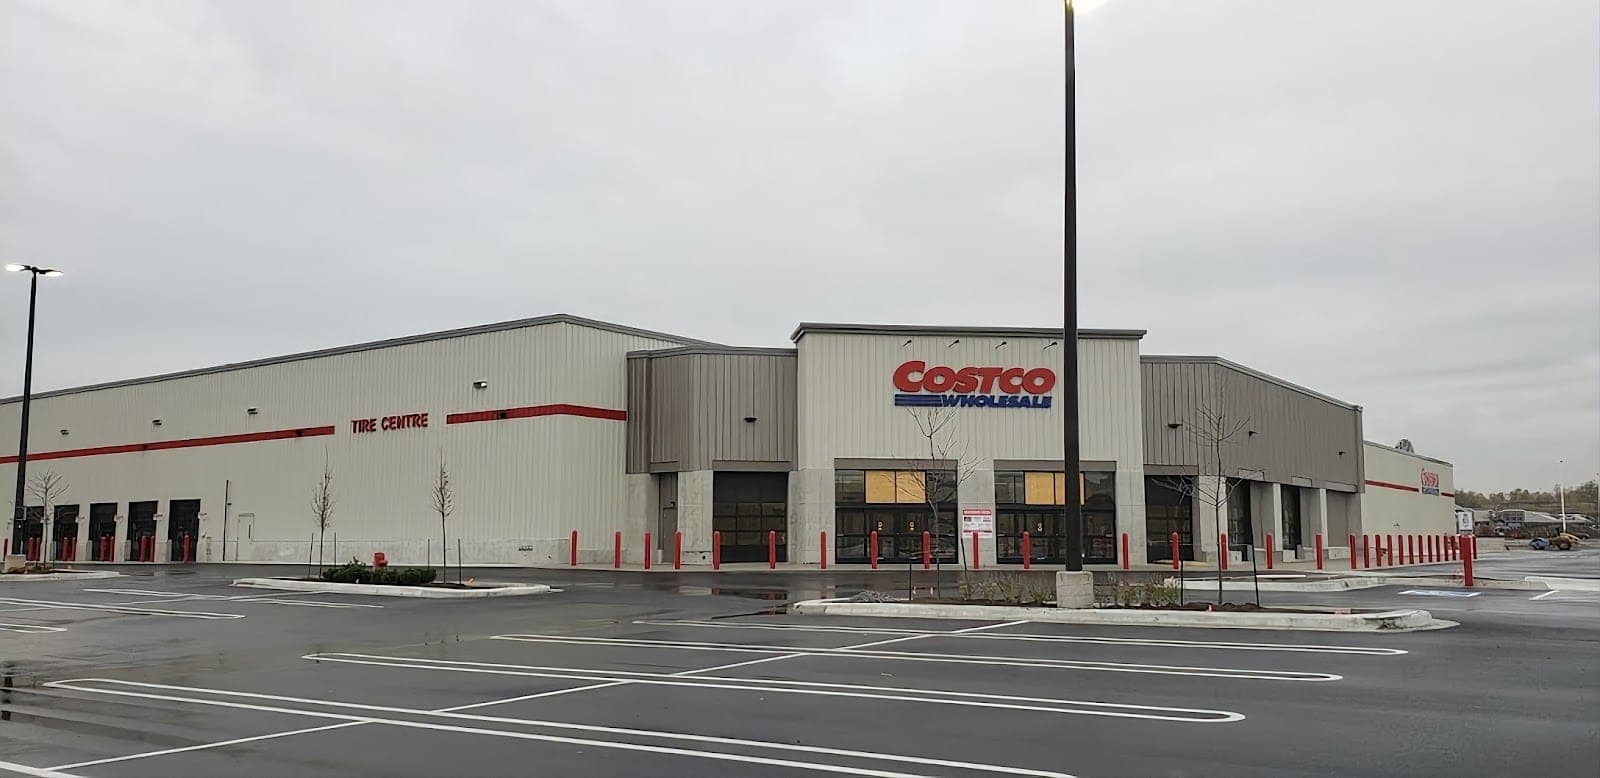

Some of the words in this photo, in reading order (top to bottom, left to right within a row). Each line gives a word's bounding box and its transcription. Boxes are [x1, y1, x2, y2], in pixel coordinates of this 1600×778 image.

[893, 360, 1056, 394] COSTCO
[941, 394, 1052, 408] WHOLESALE
[351, 418, 377, 433] TIRE
[381, 413, 428, 430] CENTRE
